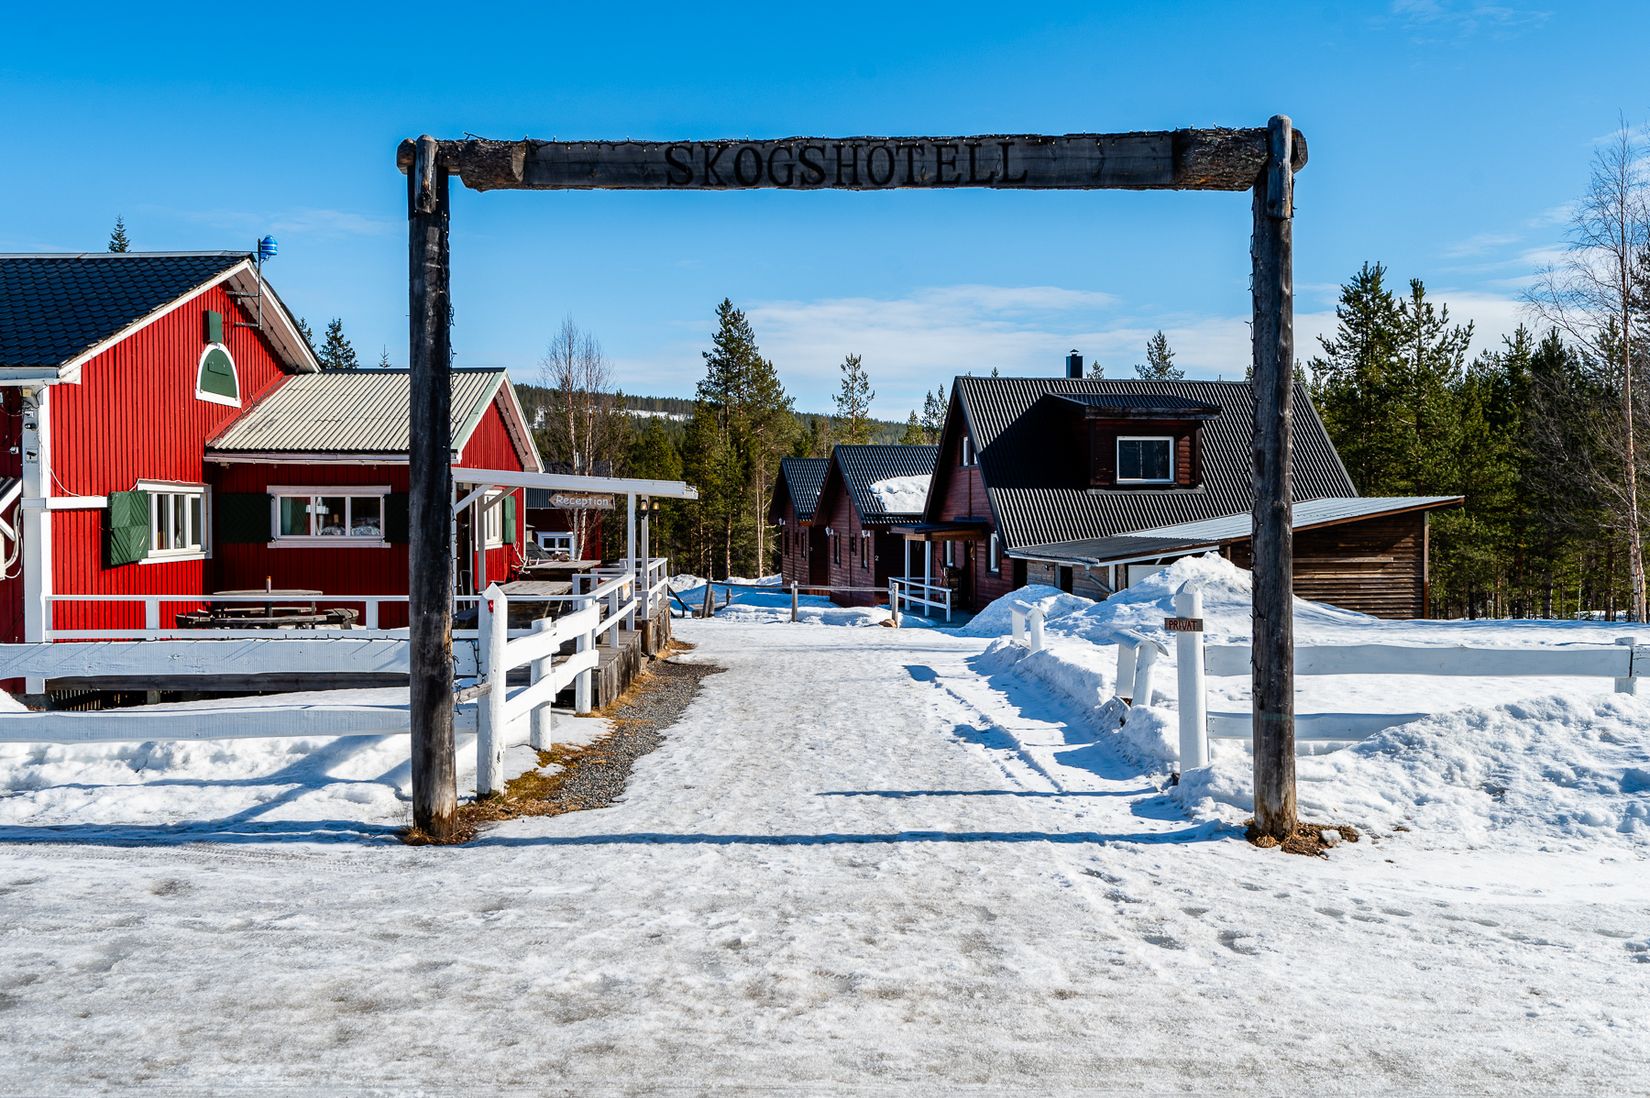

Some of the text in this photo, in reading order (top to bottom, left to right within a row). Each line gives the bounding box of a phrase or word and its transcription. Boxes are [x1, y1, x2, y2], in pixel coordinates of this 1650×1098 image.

[664, 142, 1028, 187] SKOGSHOTELL
[556, 495, 609, 508] Reception
[1168, 620, 1198, 631] PRIVAT
